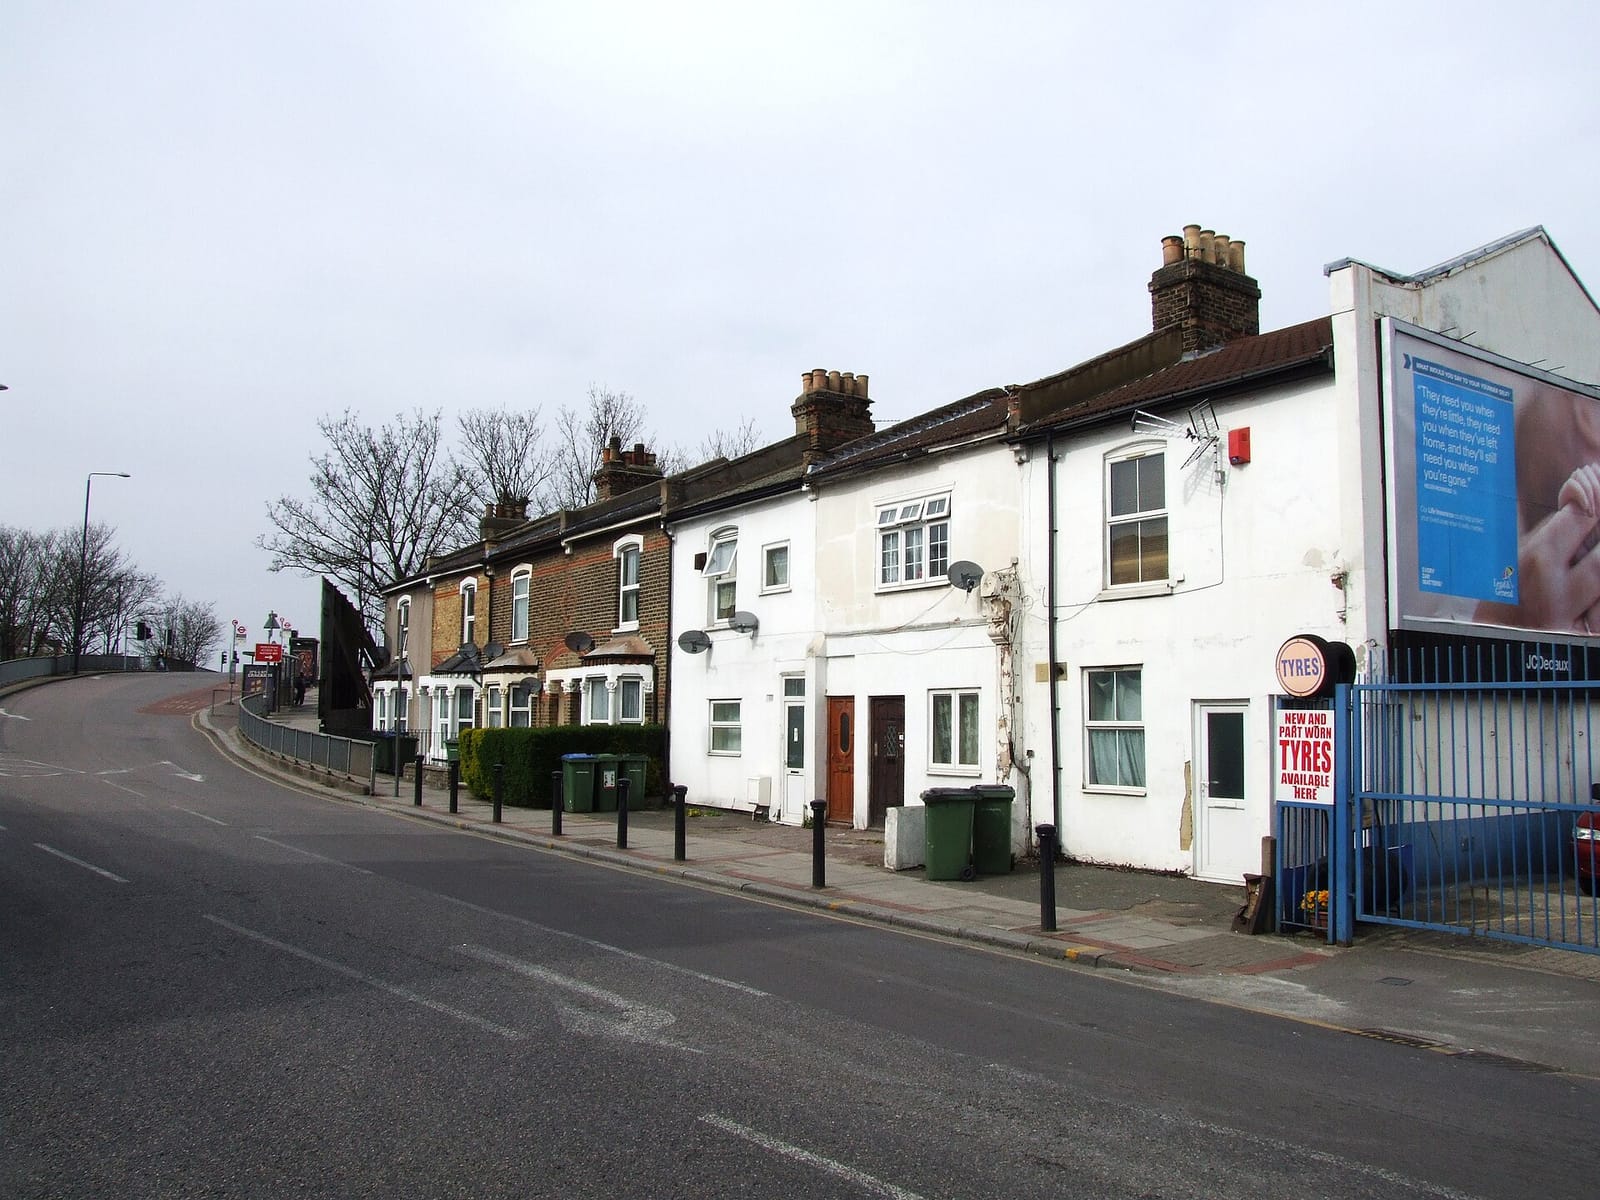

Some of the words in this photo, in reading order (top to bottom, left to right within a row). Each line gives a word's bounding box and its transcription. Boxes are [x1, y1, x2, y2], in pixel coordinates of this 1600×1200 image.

[1442, 394, 1460, 408] need
[1461, 401, 1474, 413] you
[1475, 405, 1495, 418] when
[1422, 403, 1448, 420] they're
[1467, 415, 1482, 432] they
[1483, 422, 1501, 435] need
[1422, 421, 1437, 433] you
[1438, 424, 1459, 438] when
[1423, 435, 1447, 452] home,
[1448, 442, 1462, 455] and
[1424, 453, 1442, 466] need
[1443, 458, 1459, 470] you
[1459, 462, 1479, 475] when
[1424, 469, 1447, 483] you're
[1281, 657, 1320, 677] TYRES
[1285, 712, 1307, 725] NEW
[1308, 713, 1327, 725] AND
[1279, 725, 1302, 738] PART
[1305, 725, 1332, 739] WORN
[1279, 739, 1332, 773] TYRES
[1280, 772, 1330, 787] AVAILABLE
[1294, 787, 1318, 800] HERE
